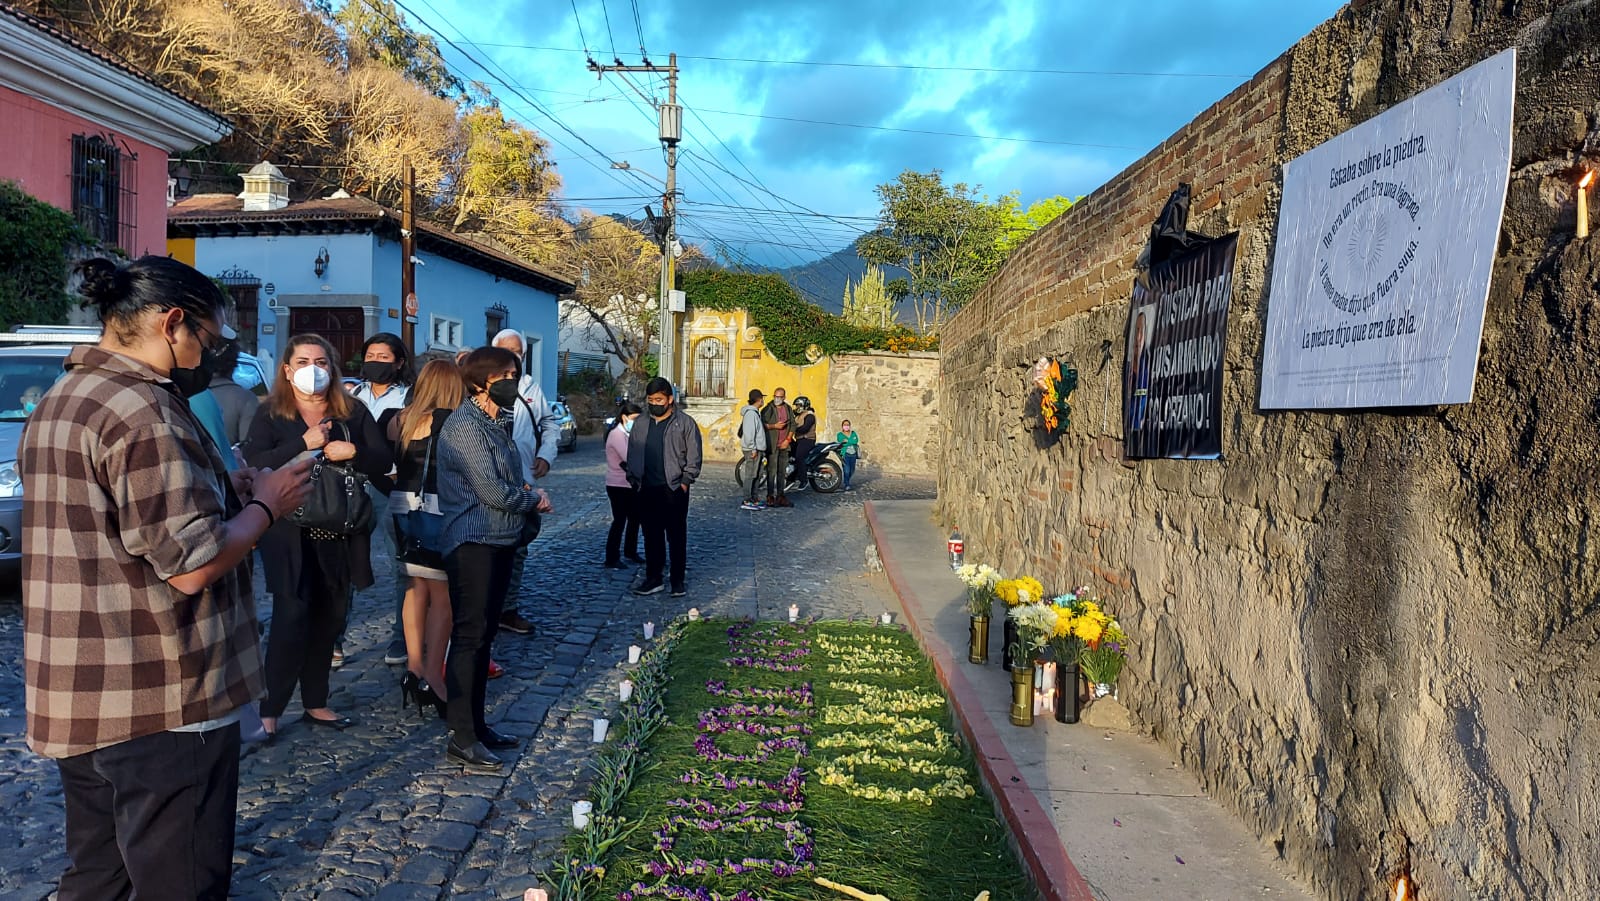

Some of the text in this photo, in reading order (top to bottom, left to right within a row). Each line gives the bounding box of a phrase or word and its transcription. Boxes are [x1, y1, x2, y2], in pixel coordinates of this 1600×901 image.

[1329, 132, 1426, 189] Estaba sobre la piedra.
[1331, 214, 1343, 235] era
[1342, 202, 1352, 219] un
[1371, 179, 1384, 198] Era
[1383, 181, 1398, 200] una
[1202, 272, 1231, 316] PARA
[1348, 294, 1361, 316] dijo
[1362, 291, 1376, 313] que
[1376, 269, 1399, 301] fuera
[1302, 307, 1416, 352] La piedra dijo que era de ella.
[1151, 332, 1220, 380] LUIS ARMANDO
